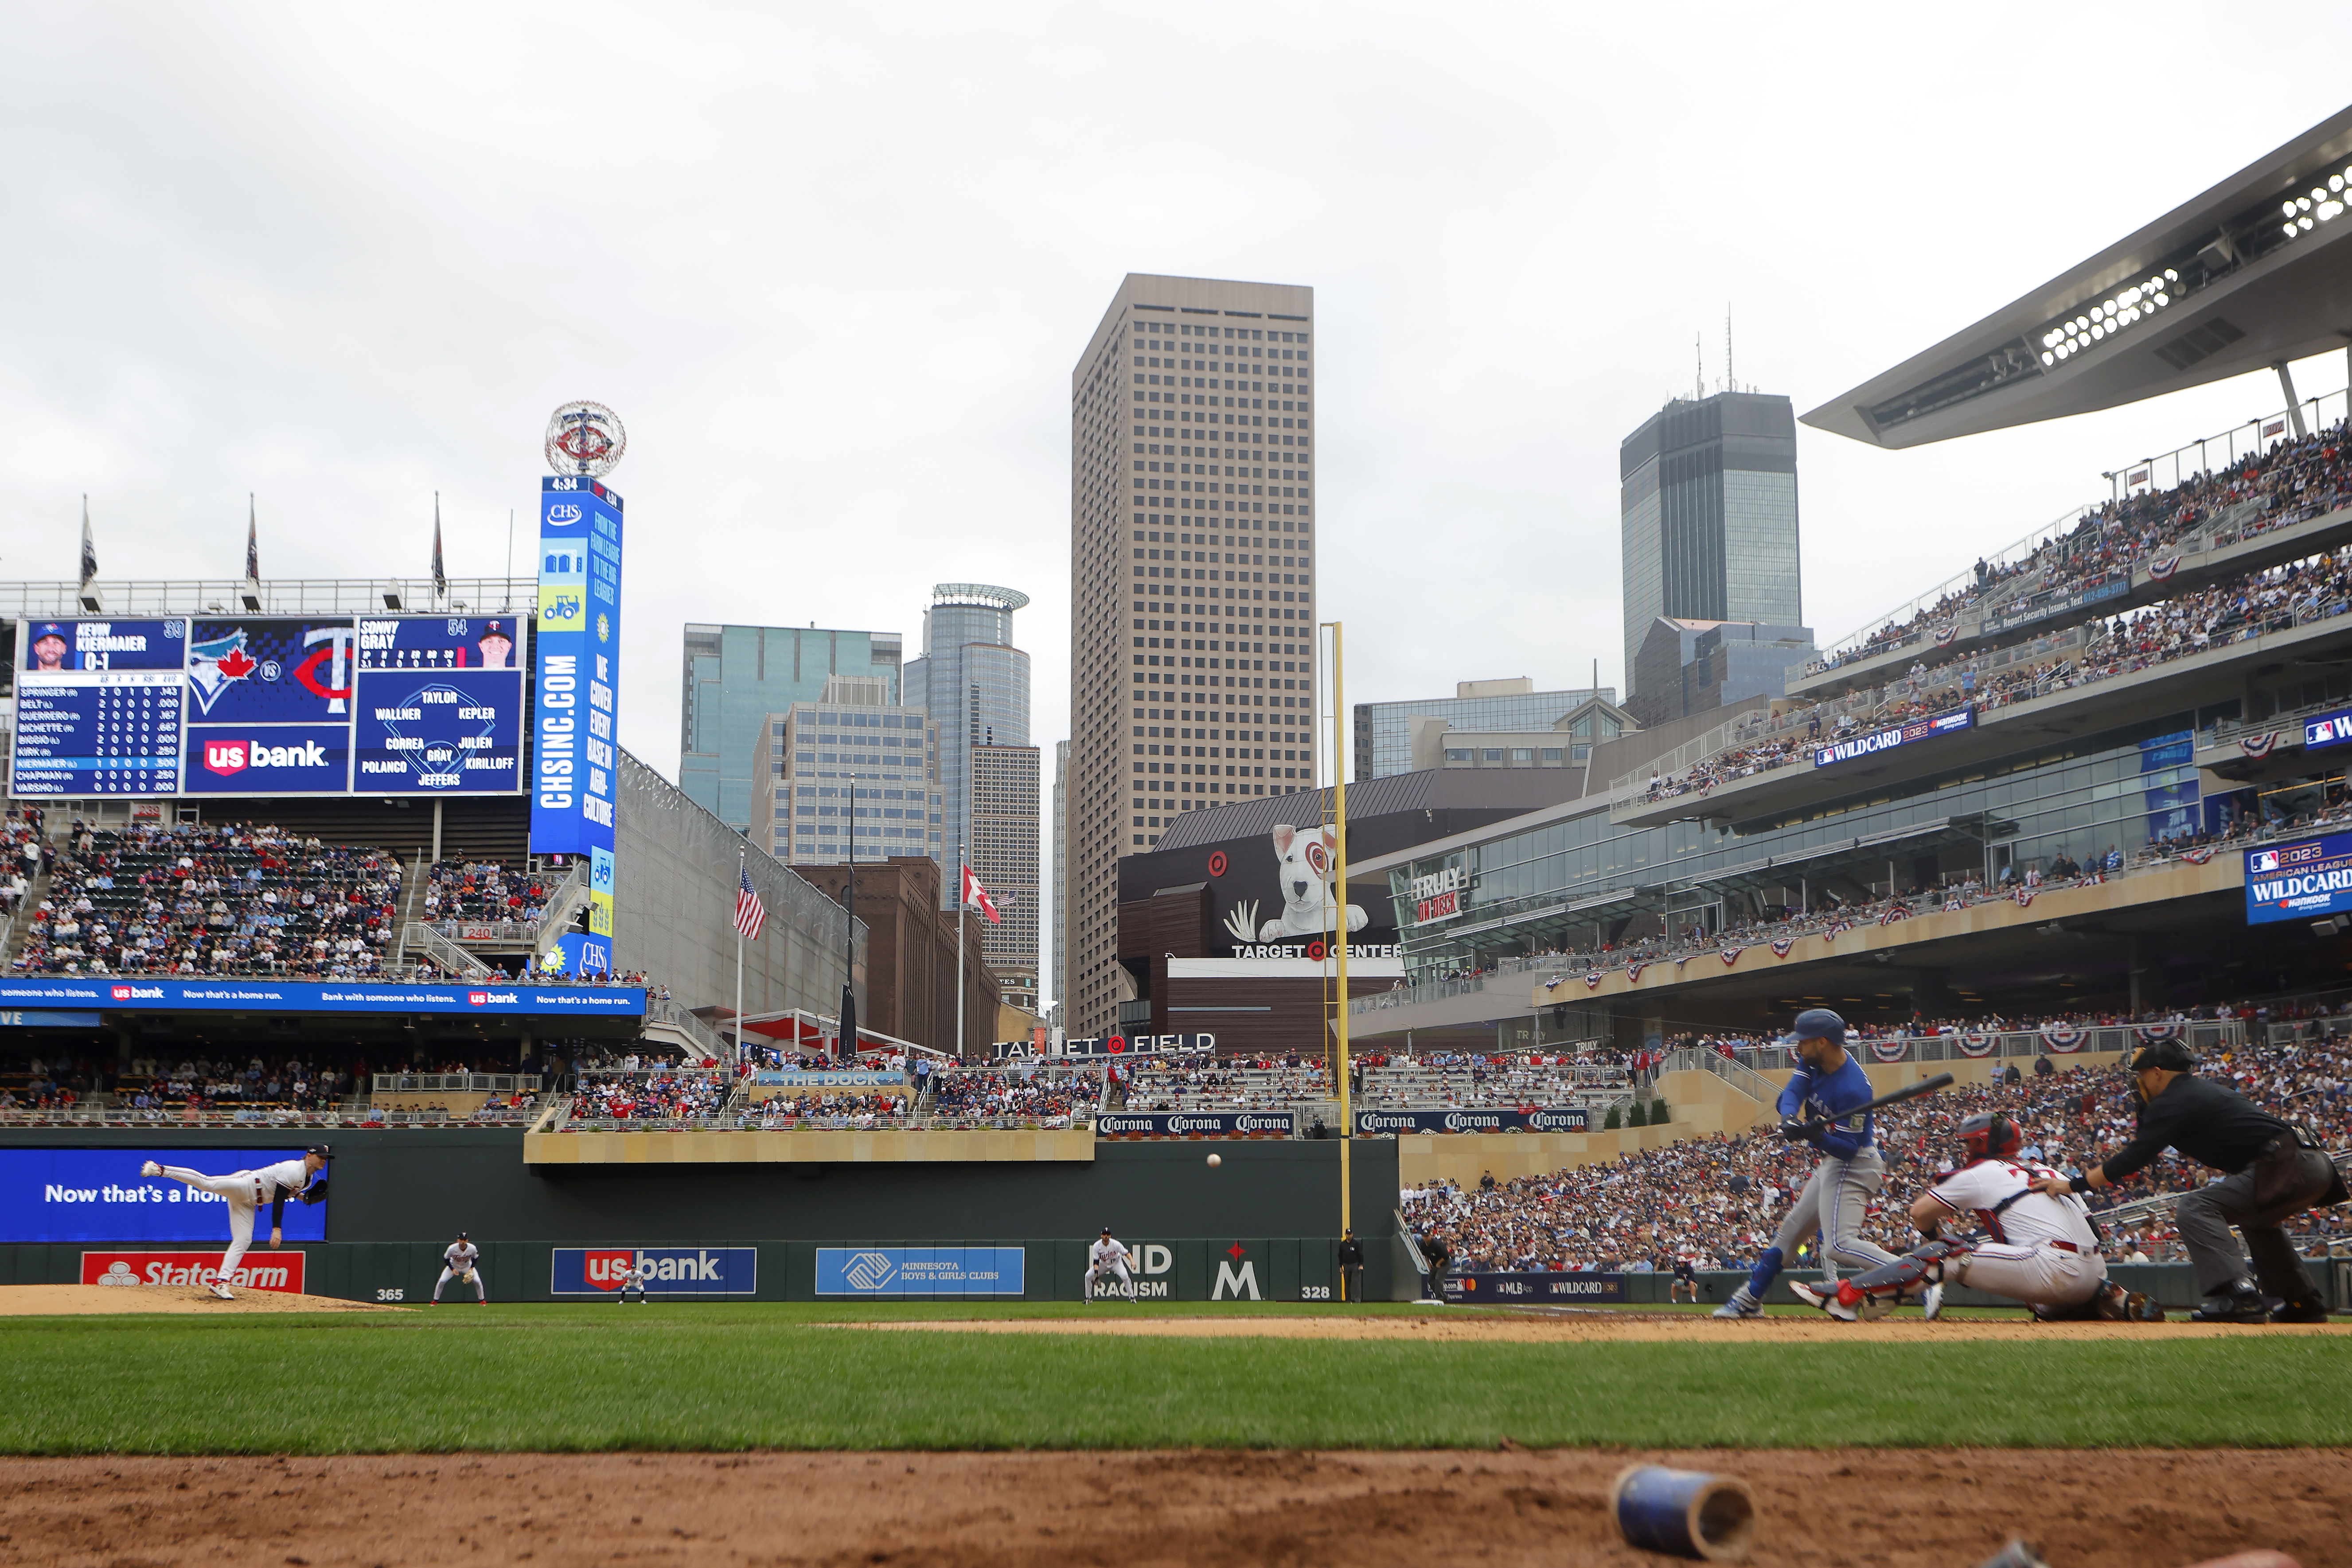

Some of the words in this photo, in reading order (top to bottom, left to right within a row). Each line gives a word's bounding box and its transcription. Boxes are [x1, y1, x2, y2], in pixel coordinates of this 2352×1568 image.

[552, 477, 578, 491] 4:34
[2132, 471, 2147, 483] 301
[550, 504, 580, 519] CHS
[2003, 614, 2023, 629] Report
[2023, 606, 2048, 622] Security
[2071, 595, 2083, 607] Text
[76, 623, 112, 636] KEVIN
[360, 620, 400, 634] SONNY
[448, 619, 468, 636] 54
[76, 636, 146, 651] KIERMAIER
[360, 634, 395, 650] GRAY
[85, 652, 109, 671] 0-1
[361, 659, 371, 668] 3.1
[396, 659, 402, 668] 0
[413, 659, 419, 668] 0
[596, 653, 608, 683] WE
[421, 691, 457, 704] TAYLOR
[590, 679, 612, 714] COVER
[375, 708, 421, 720] WALLNER
[458, 707, 495, 720] KEPLER
[540, 655, 576, 809] CHSINC.COM
[590, 708, 611, 741] EVERY
[1903, 725, 1928, 739] 2023
[386, 737, 425, 750] CORREA
[458, 737, 493, 749] JULIEN
[209, 747, 244, 768] us
[250, 740, 326, 767] bank
[427, 749, 452, 762] GRAY
[587, 736, 605, 768] BASE
[605, 745, 612, 770] IN
[362, 761, 407, 773] POLANCO
[465, 757, 514, 770] KIRILLOFF
[418, 773, 460, 786] JEFFERS
[583, 793, 612, 828] CULTURE
[2280, 846, 2322, 863] 2023
[2253, 866, 2309, 882] AMERICAN
[1413, 866, 1460, 899] TRULY
[1433, 891, 1458, 917] DECK
[468, 928, 490, 938] 240
[583, 941, 605, 968] CHS
[1232, 945, 1306, 959] TARGET
[44, 988, 65, 997] who
[113, 989, 130, 998] us
[130, 986, 164, 999] bank
[183, 990, 204, 999] Now
[205, 990, 230, 999] that's
[238, 990, 264, 999] home
[322, 992, 343, 1001] Bank
[344, 992, 364, 1001] with
[406, 994, 425, 1002] who
[426, 994, 456, 1002] listens.
[471, 995, 485, 1003] us
[487, 992, 519, 1003] bank
[558, 996, 580, 1004] that's
[589, 996, 612, 1005] home
[1135, 1033, 1214, 1052] FIELD
[1576, 1040, 1597, 1051] TRULY
[780, 1074, 819, 1086] THE
[824, 1074, 881, 1086] DOCK
[1100, 1116, 1153, 1134] Corona
[1168, 1115, 1221, 1134] Corona
[1236, 1114, 1290, 1134] Corona
[1361, 1112, 1416, 1132] Corona
[1445, 1112, 1500, 1132] Corona
[1529, 1112, 1584, 1132] Corona
[45, 1184, 98, 1203] Now
[101, 1184, 163, 1203] that's
[168, 1189, 181, 1203] a
[1098, 1251, 1116, 1261] Twins
[590, 1258, 628, 1281] us
[938, 1272, 966, 1280] GIRLS
[969, 1272, 999, 1280] CLUBS
[376, 1288, 404, 1301] 365
[1302, 1286, 1330, 1299] 328
[1506, 1282, 1523, 1295] MLB
